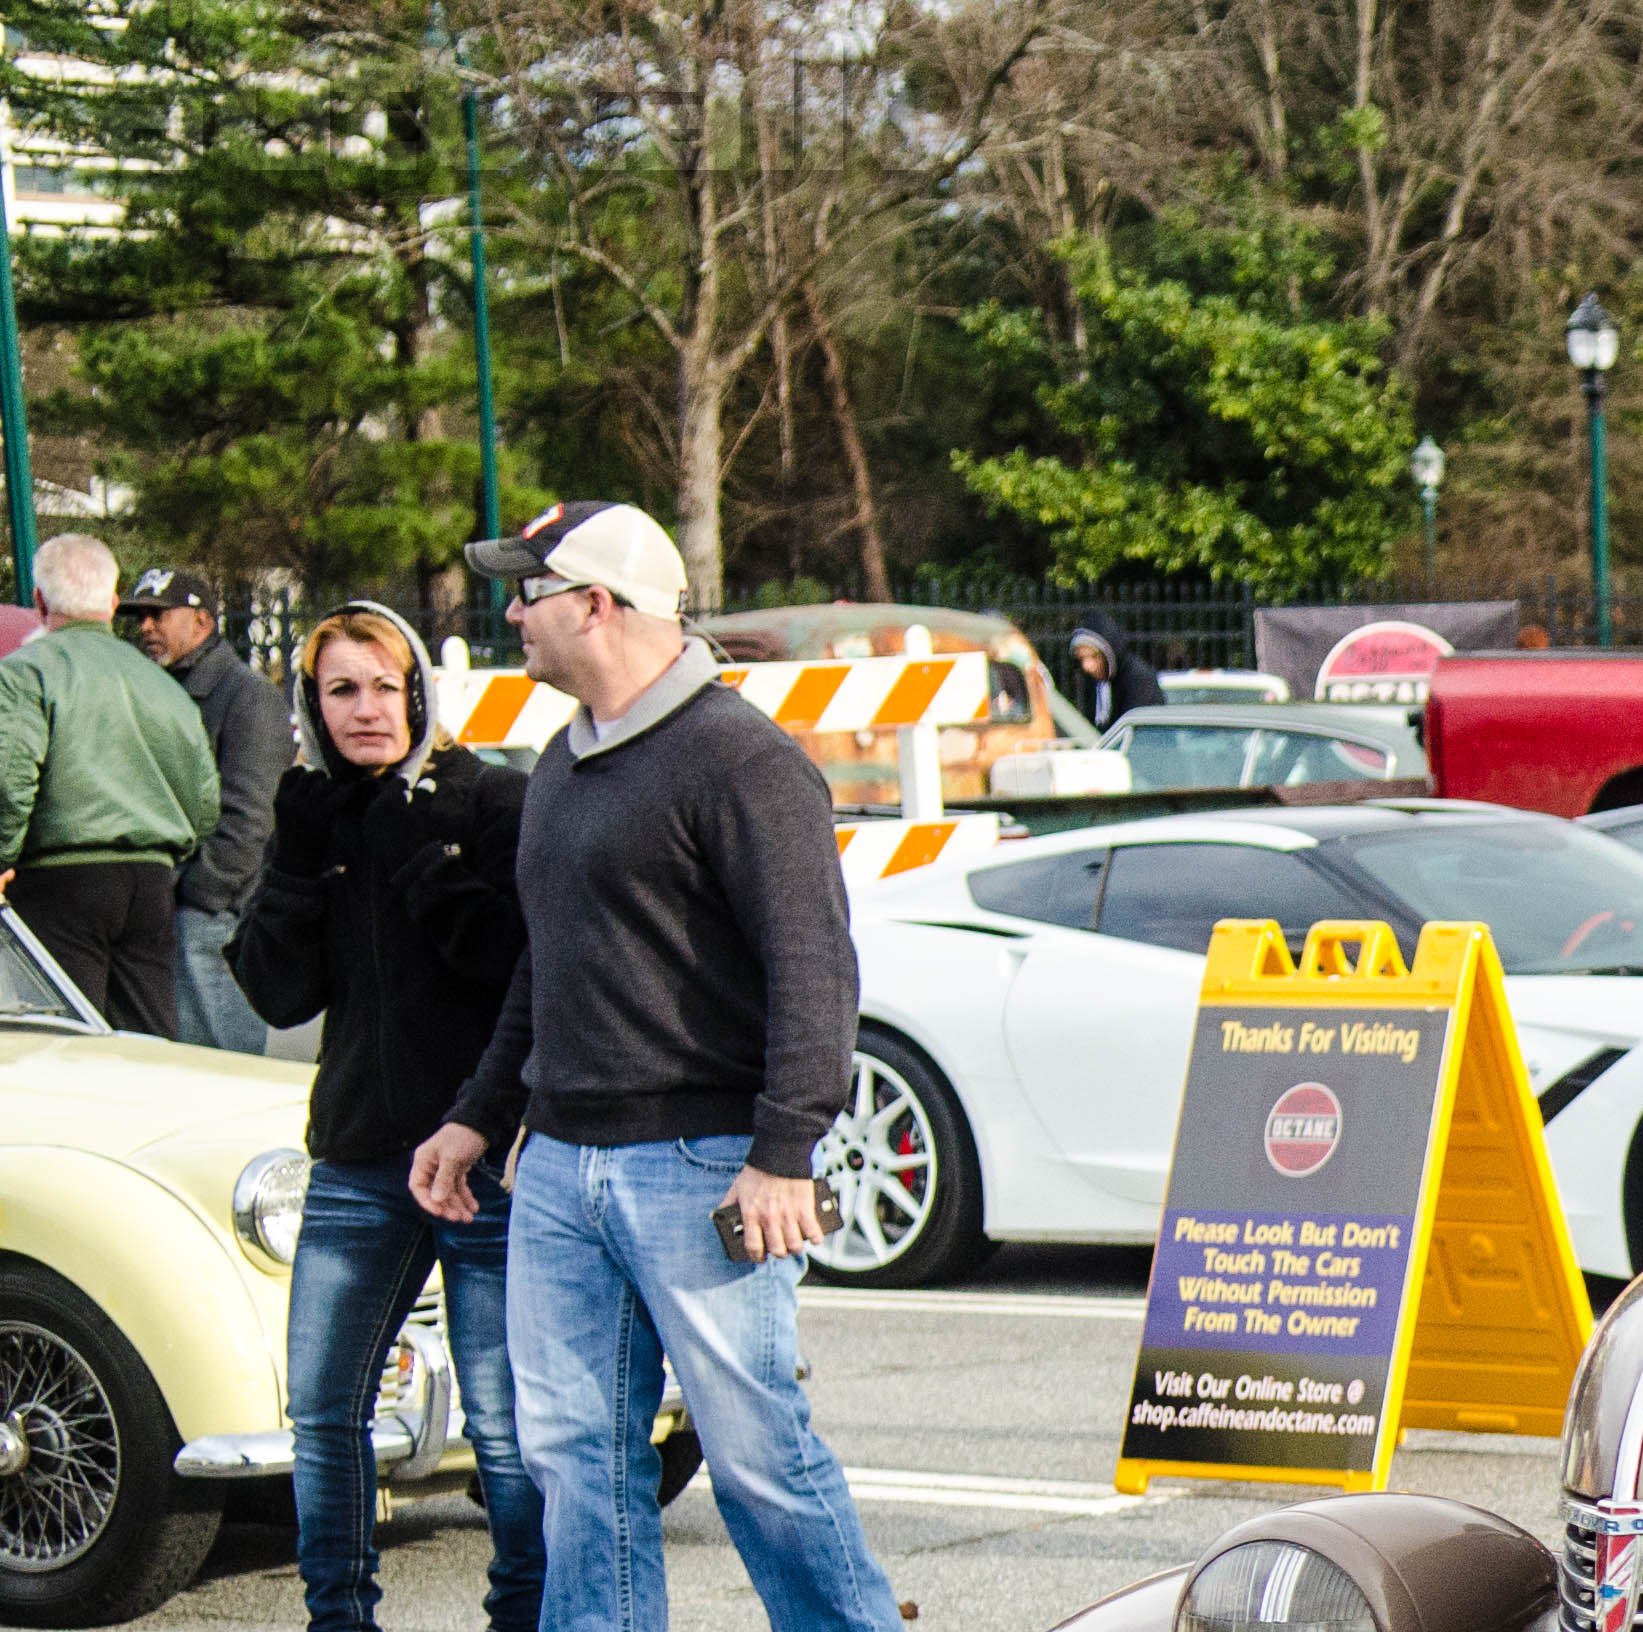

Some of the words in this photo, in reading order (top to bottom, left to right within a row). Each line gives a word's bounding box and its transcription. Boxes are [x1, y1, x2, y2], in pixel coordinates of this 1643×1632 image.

[1221, 1020, 1295, 1053] Thanks
[1298, 1022, 1337, 1053] For
[1341, 1022, 1420, 1063] Visiting
[1272, 1118, 1337, 1138] OCTANE
[1175, 1217, 1239, 1243] Please
[1243, 1219, 1295, 1246] Look
[1299, 1221, 1337, 1247] But
[1341, 1222, 1401, 1249] Don't
[1203, 1247, 1266, 1273] Touch
[1271, 1250, 1310, 1275] The
[1316, 1251, 1361, 1277] Cars
[1178, 1276, 1263, 1304] Without
[1267, 1279, 1378, 1308] Permission
[1183, 1306, 1238, 1333] From
[1243, 1308, 1282, 1335] The
[1287, 1310, 1360, 1337] Owner
[1154, 1370, 1194, 1398] Visit
[1197, 1373, 1233, 1399] Our
[1235, 1374, 1294, 1401] Online
[1297, 1377, 1343, 1404] Store
[1131, 1400, 1377, 1436] shop.caffeineandoctane.com
